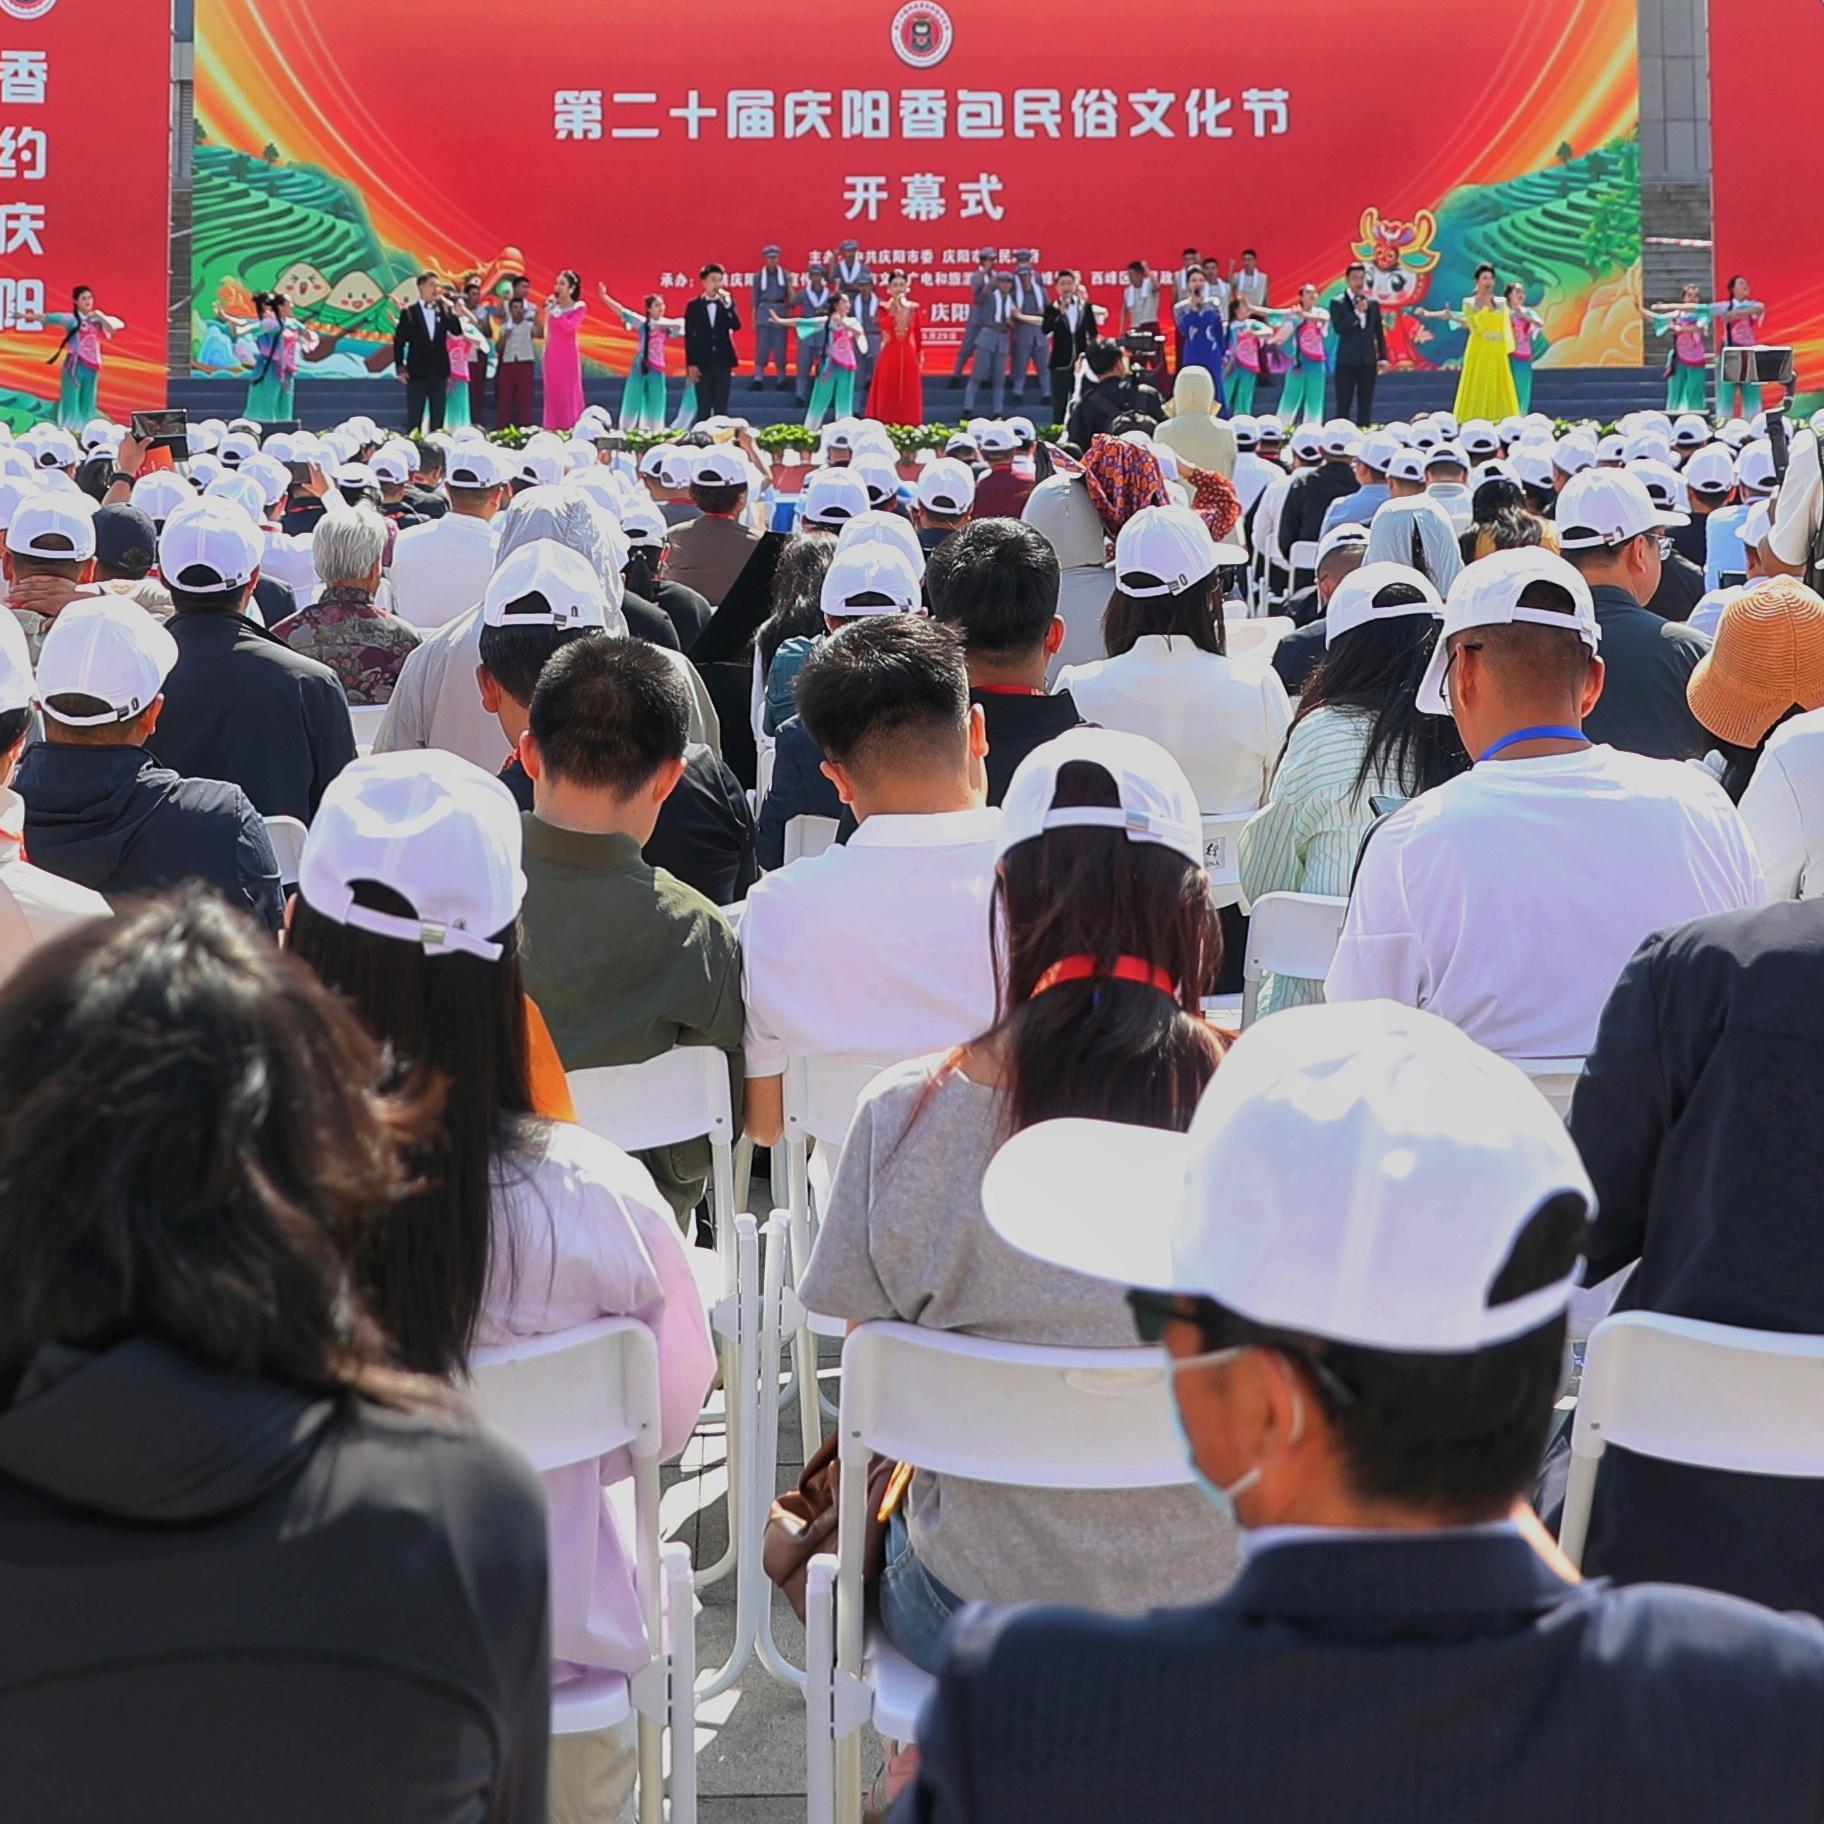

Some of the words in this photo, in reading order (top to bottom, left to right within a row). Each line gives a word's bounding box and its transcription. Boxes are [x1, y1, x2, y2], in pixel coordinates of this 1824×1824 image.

[554, 88, 1289, 140] 第二十届庆阳香包民俗文化节
[843, 173, 1004, 221] 开幕式
